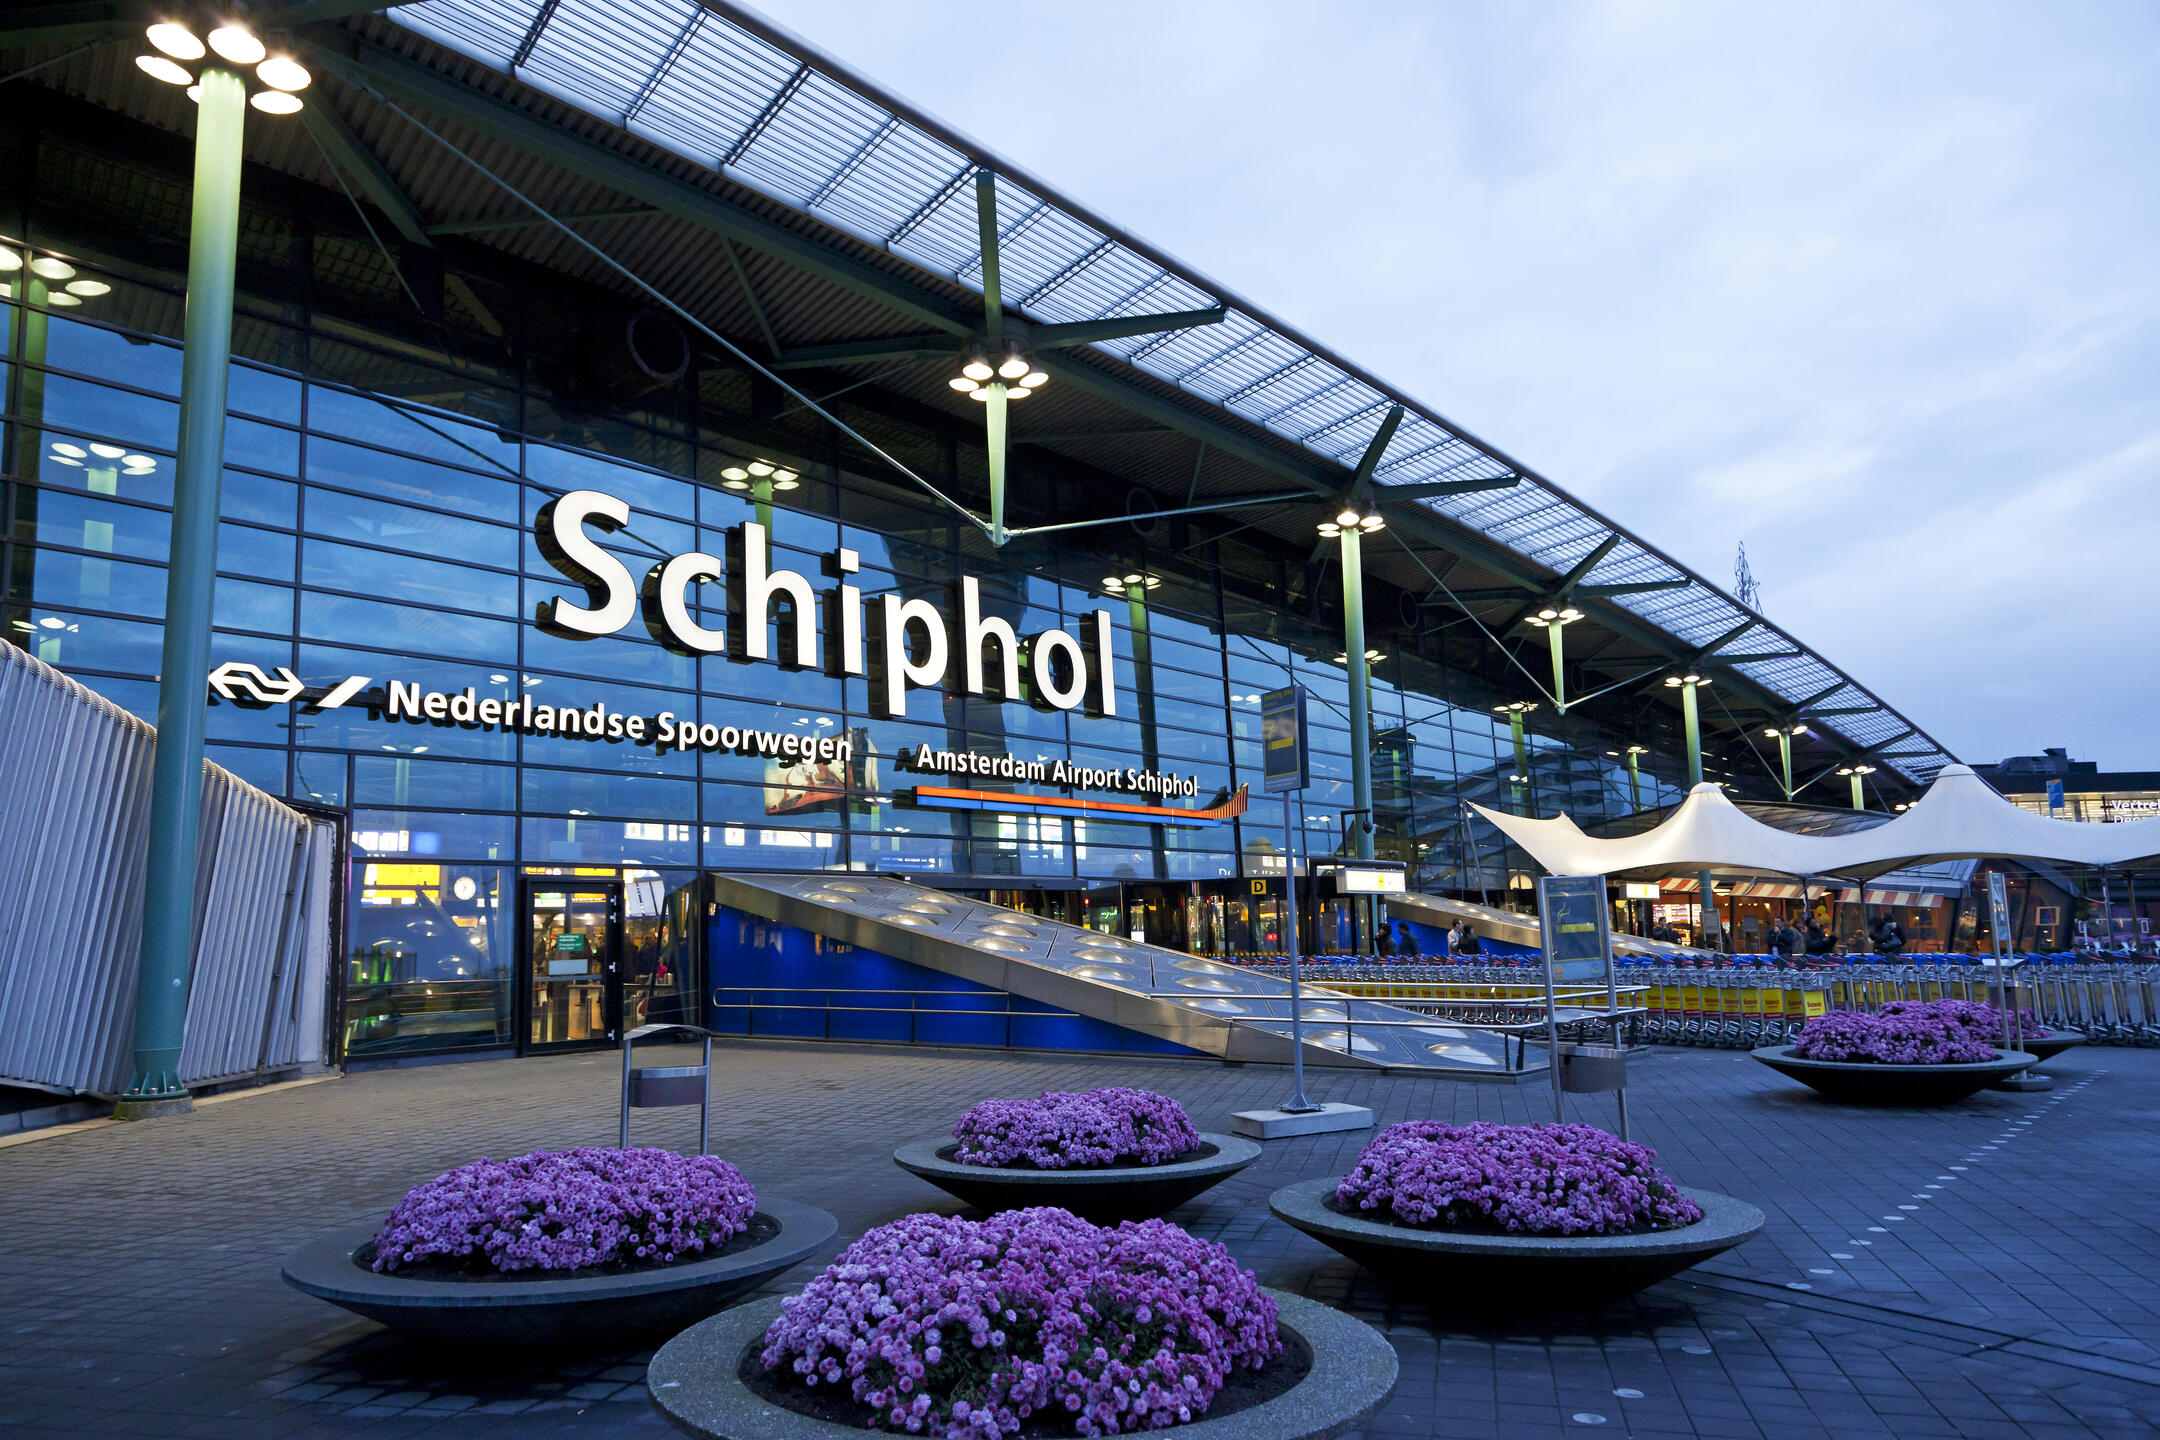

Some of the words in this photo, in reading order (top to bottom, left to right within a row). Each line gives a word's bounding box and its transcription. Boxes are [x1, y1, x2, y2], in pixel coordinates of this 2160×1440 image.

[553, 490, 1116, 716] Schiphol
[389, 679, 646, 739] Nederlandse
[657, 711, 852, 765] Spoorwegen
[917, 743, 1046, 781] Amsterdam
[1052, 759, 1122, 791] Airport
[1127, 768, 1198, 799] Schiphol
[1254, 882, 1263, 892] D
